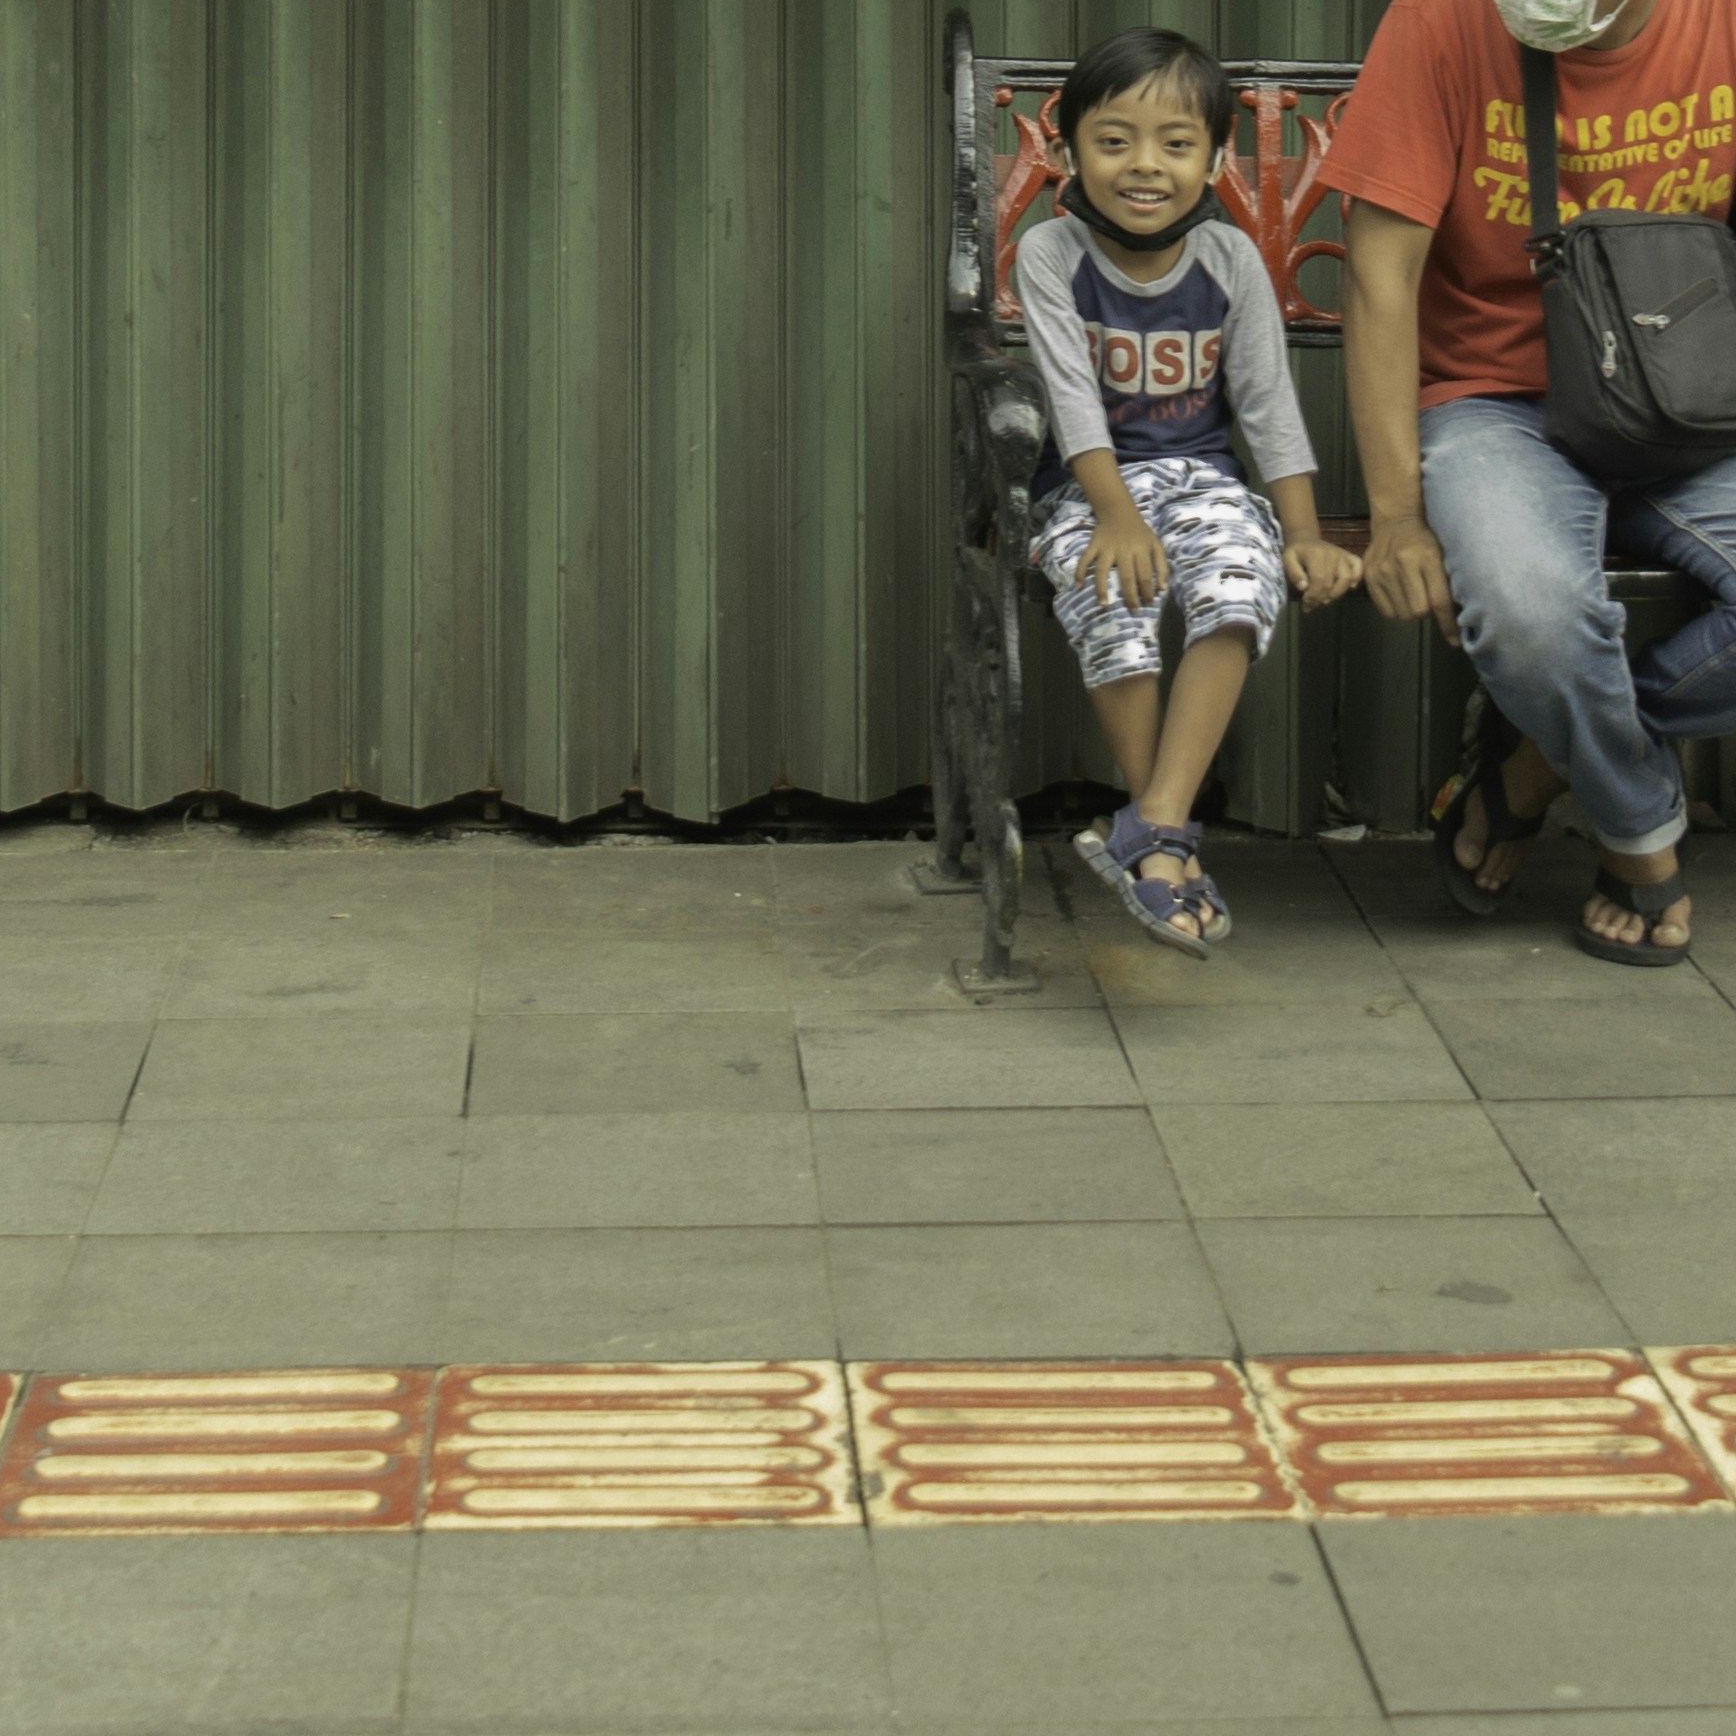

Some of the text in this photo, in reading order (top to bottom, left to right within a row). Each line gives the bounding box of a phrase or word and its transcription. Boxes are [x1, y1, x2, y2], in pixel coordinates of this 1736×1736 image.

[1575, 114, 1612, 151] IS
[1623, 92, 1700, 143] NOT
[1709, 83, 1735, 122] A
[1486, 136, 1659, 174] REPENTATIVE
